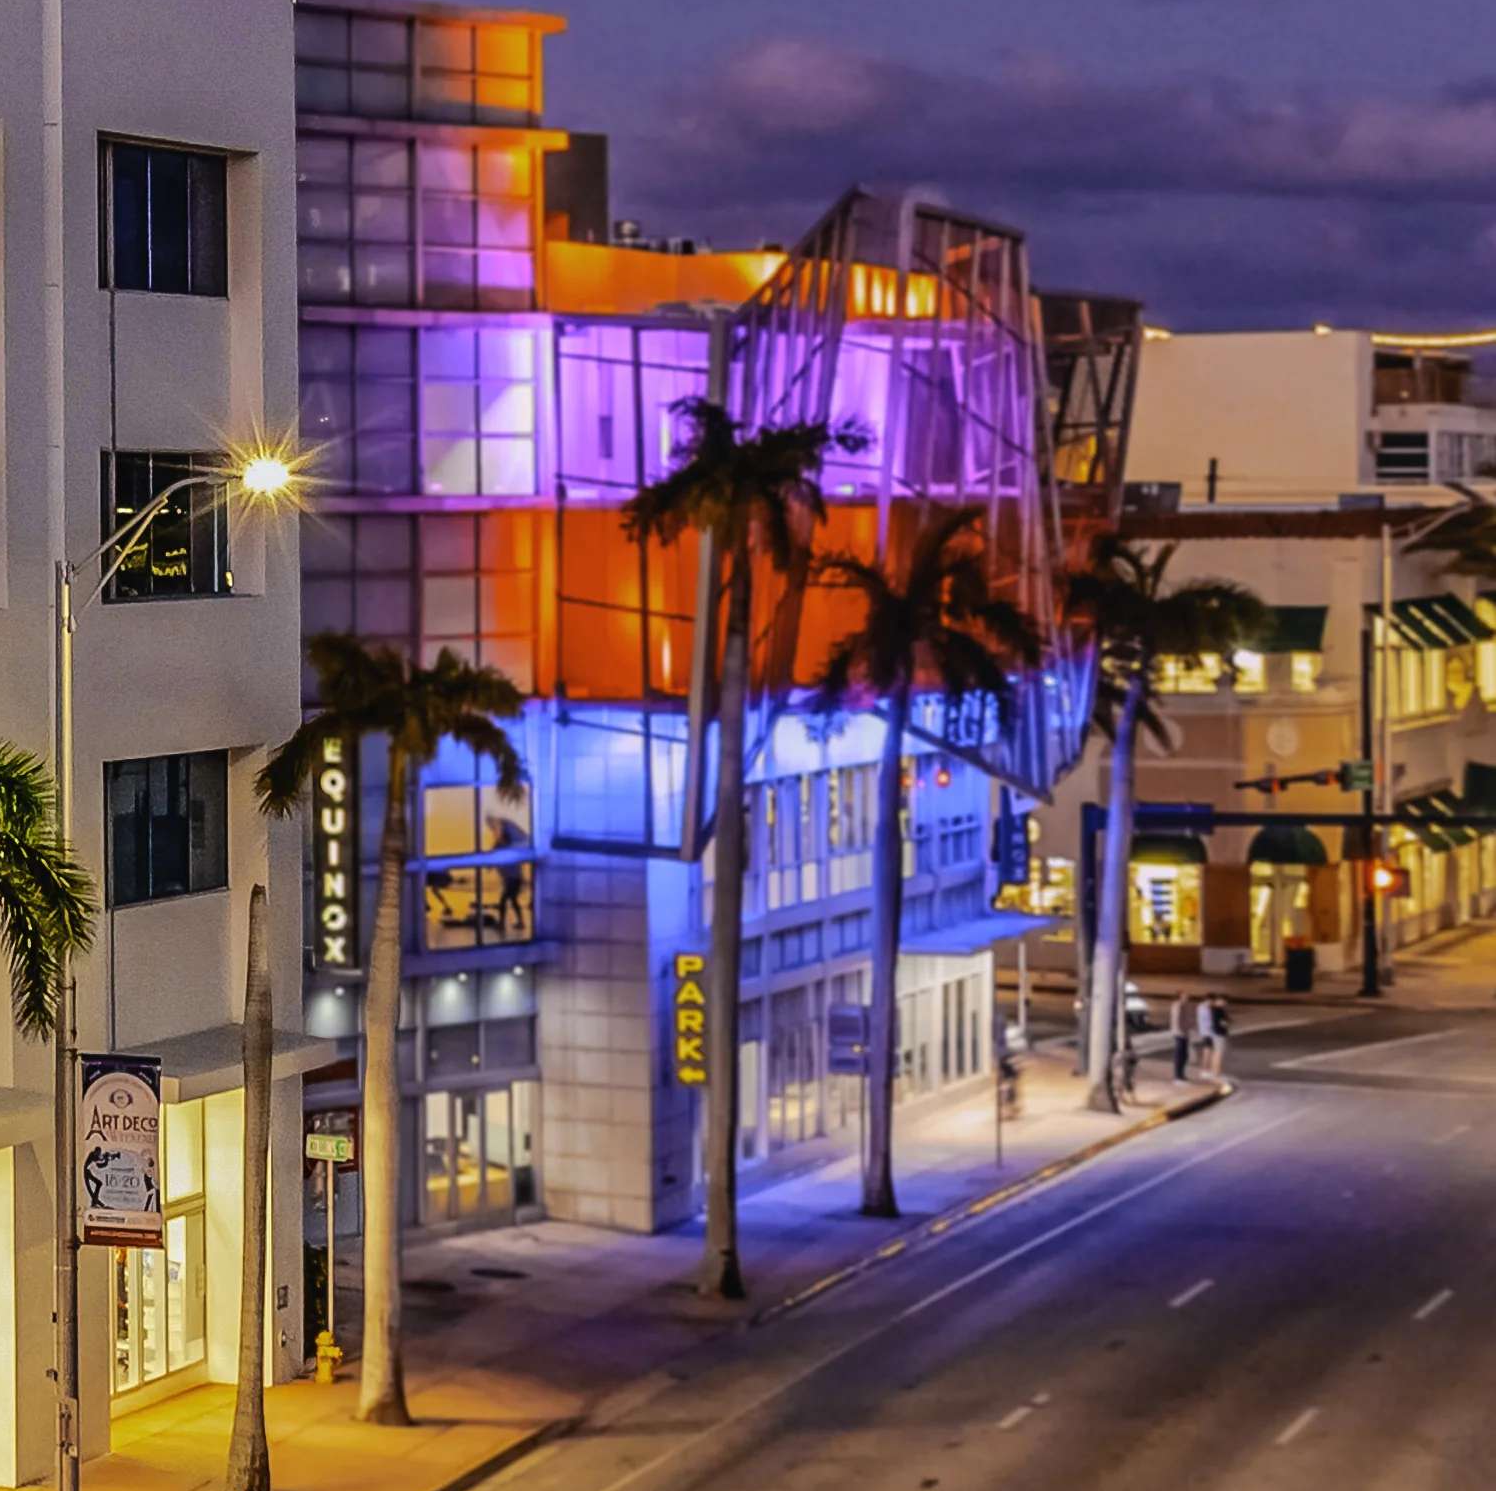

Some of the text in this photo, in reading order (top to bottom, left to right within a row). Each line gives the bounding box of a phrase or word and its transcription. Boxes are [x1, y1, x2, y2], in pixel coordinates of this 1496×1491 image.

[319, 736, 348, 964] EQUINOX
[676, 953, 706, 1062] PARK
[84, 1104, 159, 1142] ART DECO
